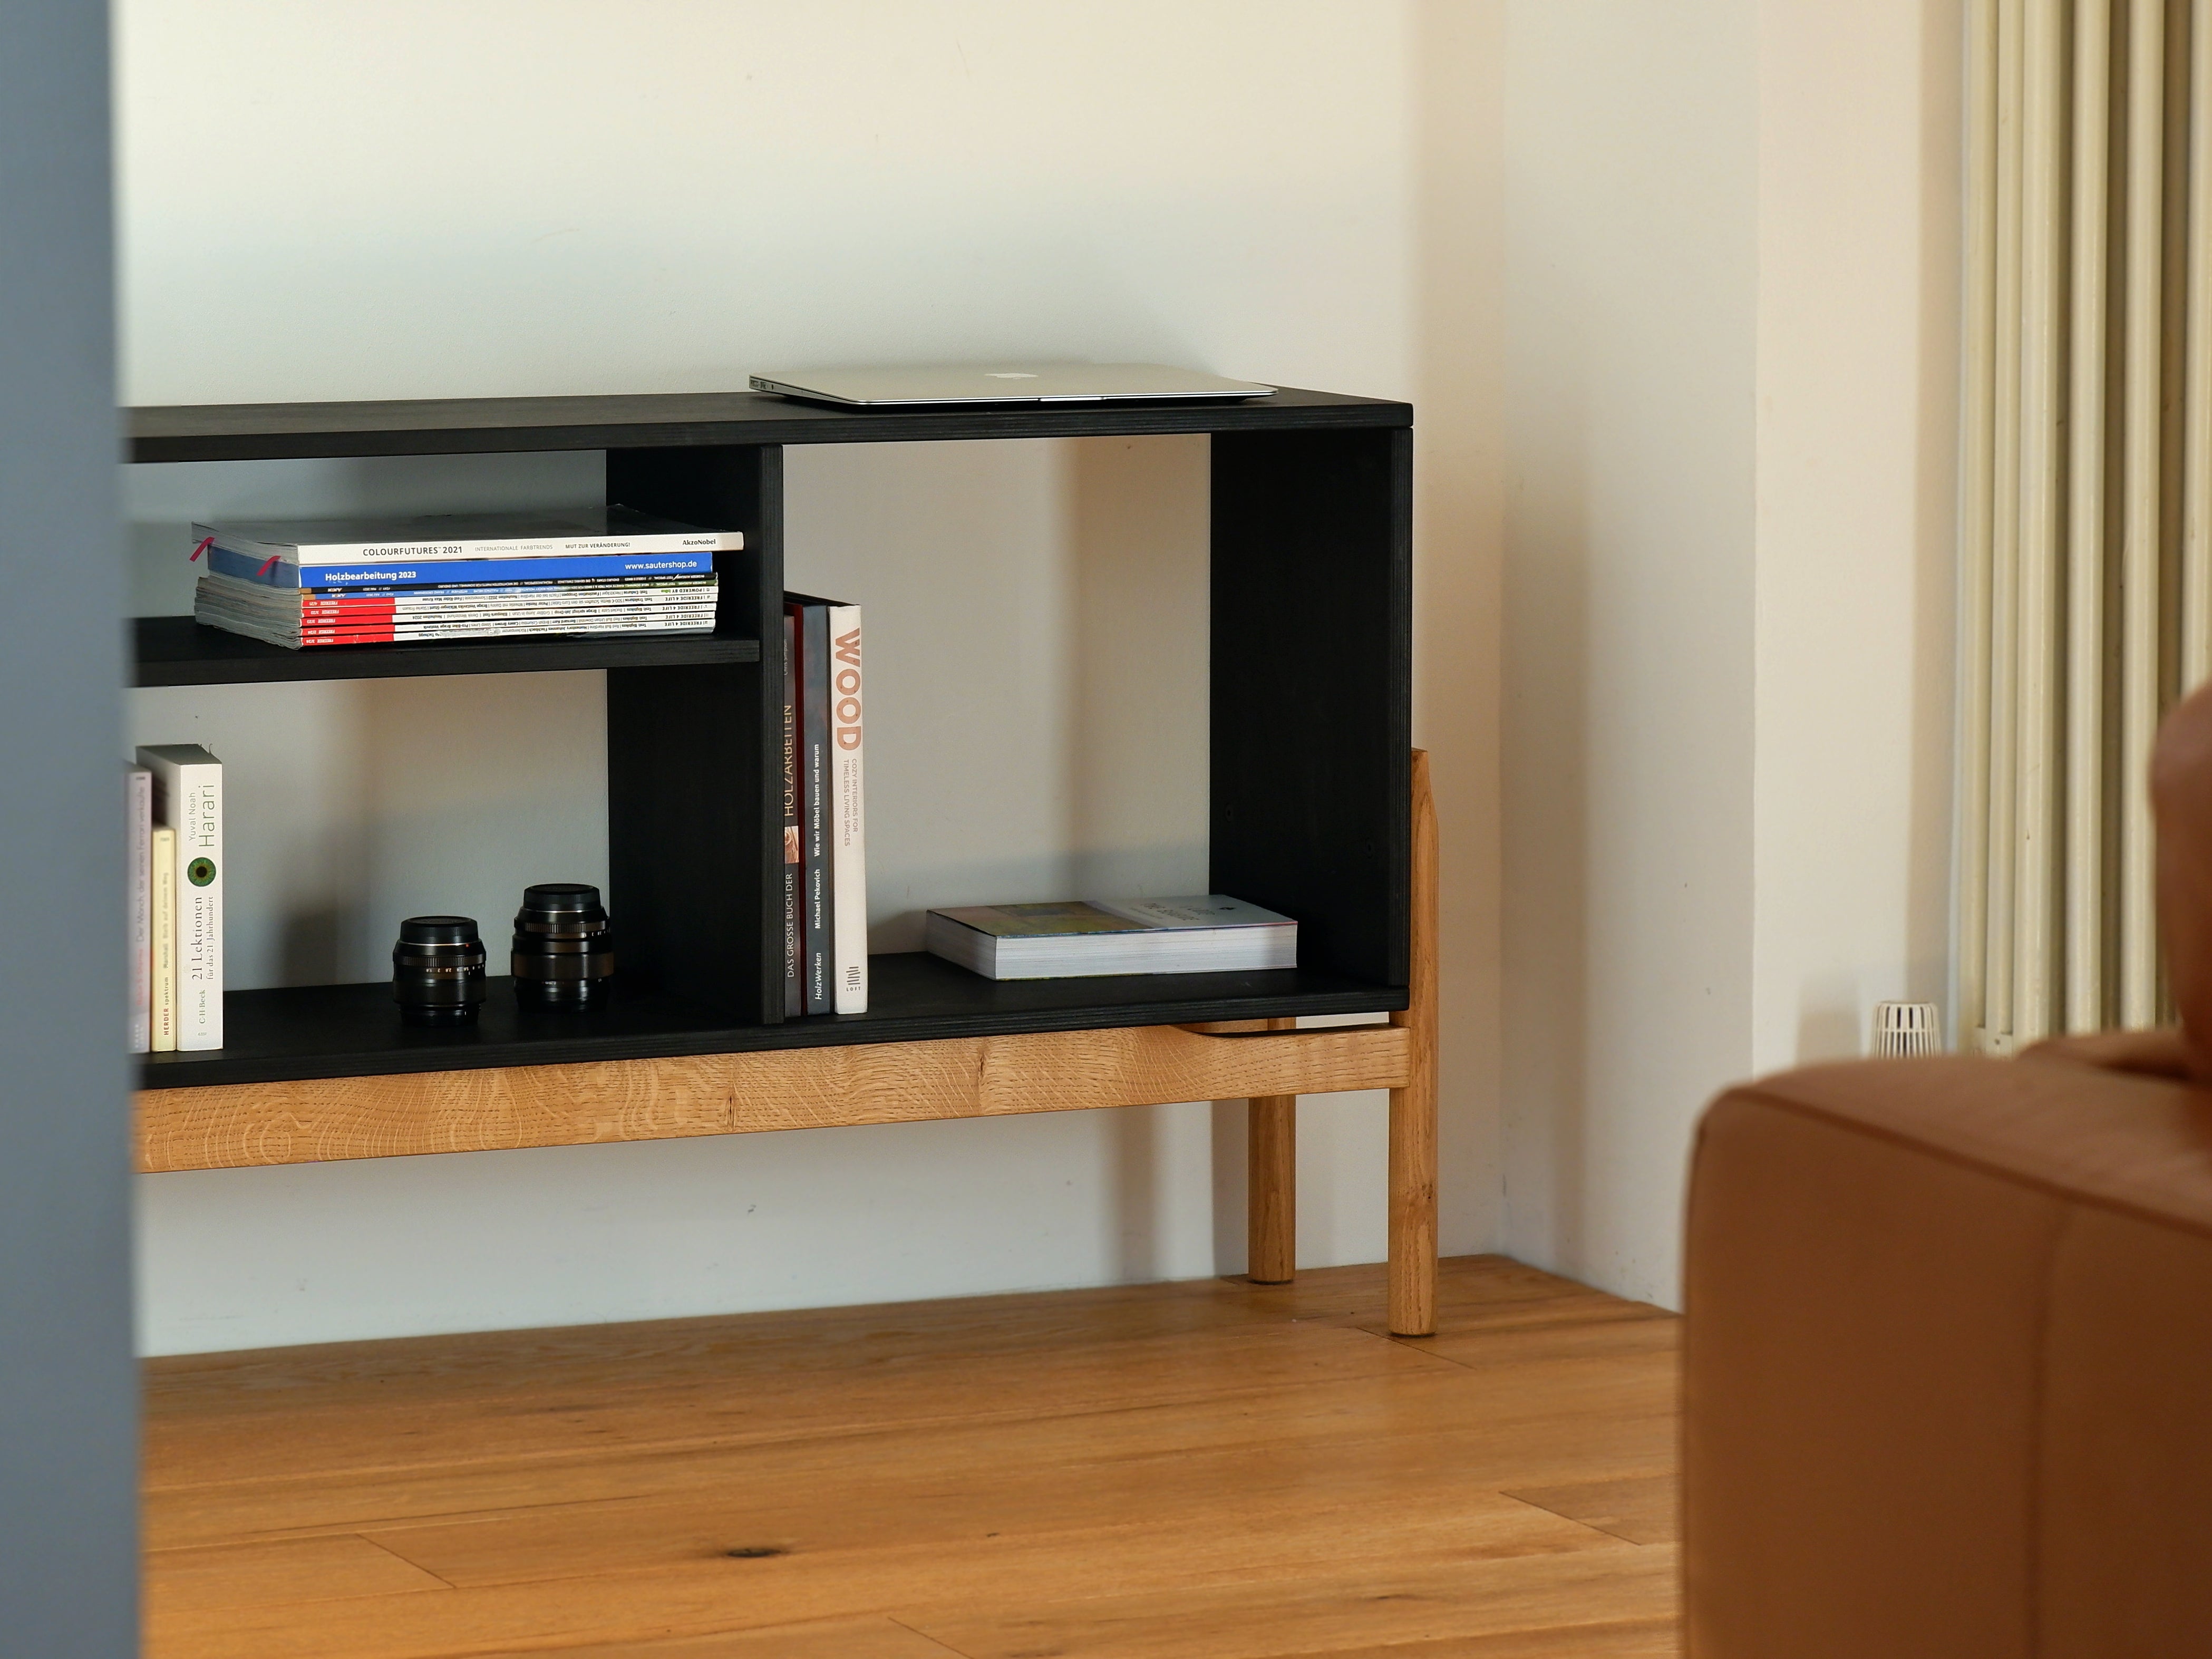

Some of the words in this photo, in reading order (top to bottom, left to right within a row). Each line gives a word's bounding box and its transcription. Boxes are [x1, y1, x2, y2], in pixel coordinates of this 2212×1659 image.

[325, 571, 397, 581] Holzbearbeitung
[625, 560, 697, 570] www.sautershop.de
[835, 627, 861, 751] WOOD
[198, 785, 215, 847] Harari
[206, 896, 215, 942] Jahrhundert
[785, 894, 794, 919] BUCH
[190, 896, 202, 962] Lektionen
[786, 921, 794, 956] GROSSE
[192, 968, 202, 980] 21
[787, 958, 795, 977] DAS
